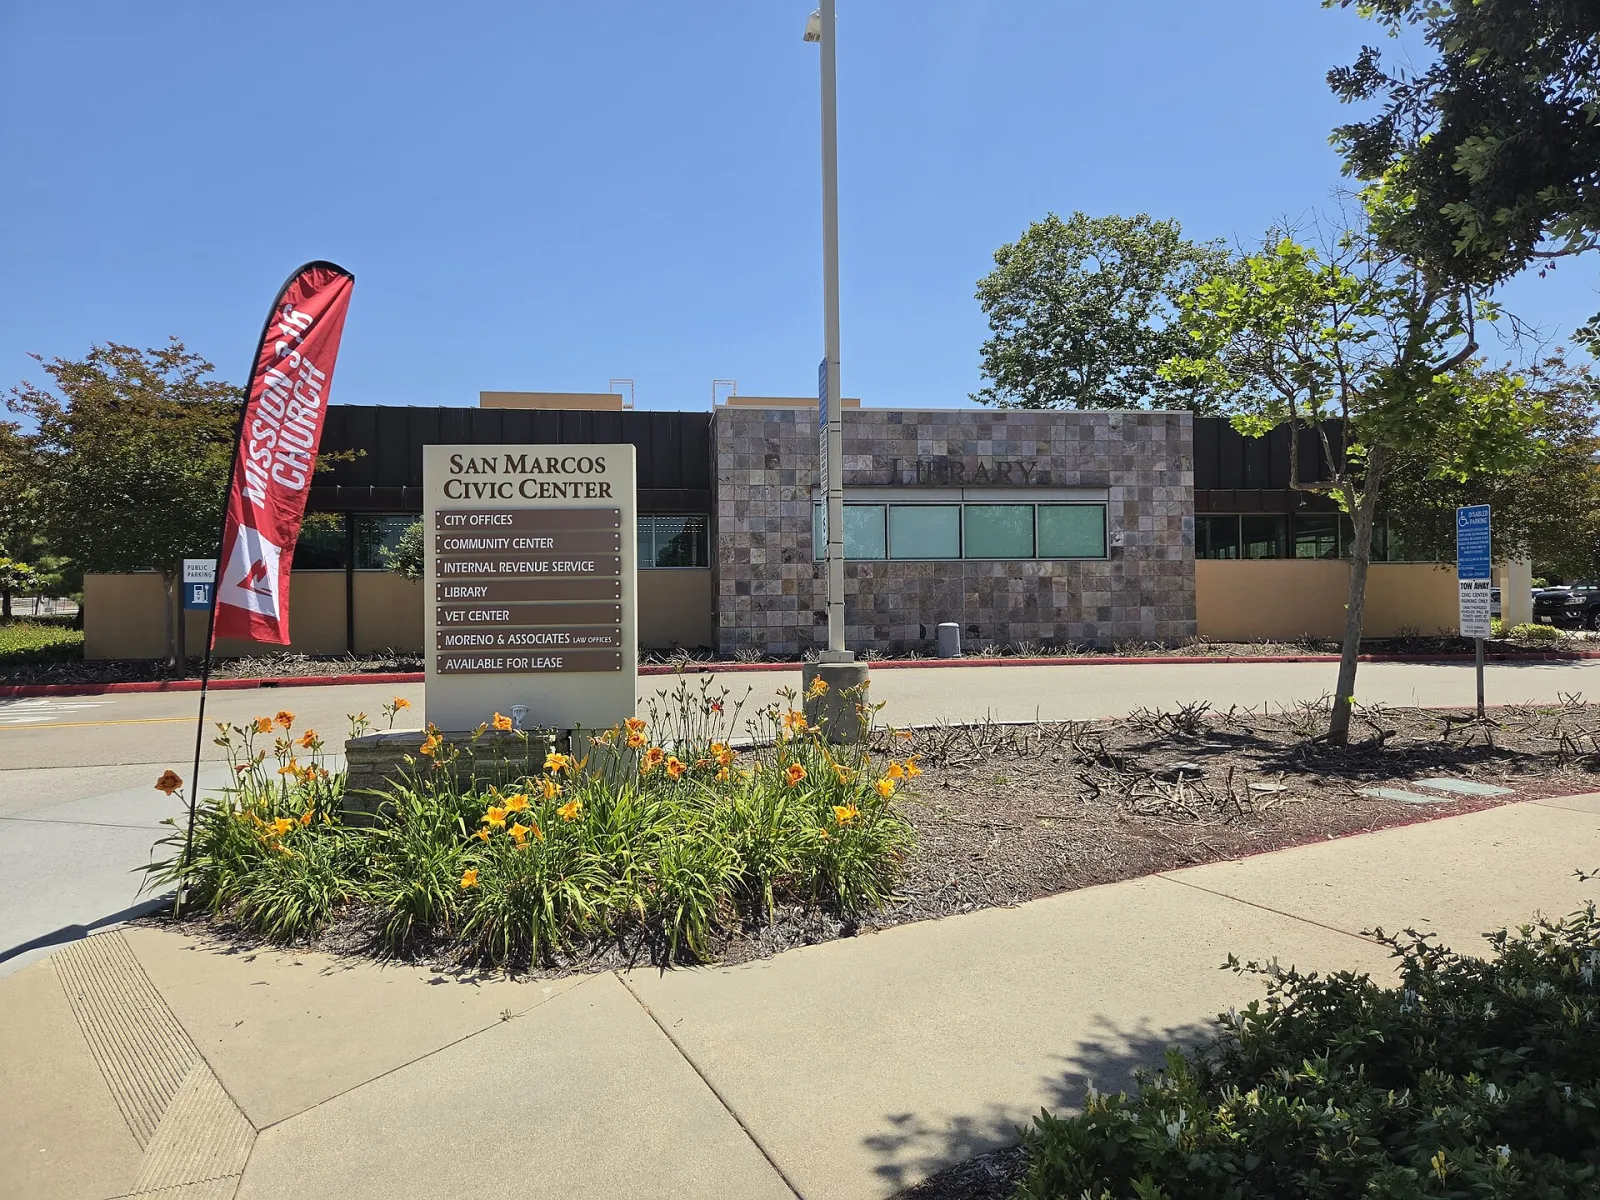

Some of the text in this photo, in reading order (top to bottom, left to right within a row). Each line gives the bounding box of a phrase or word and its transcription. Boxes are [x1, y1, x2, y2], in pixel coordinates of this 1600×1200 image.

[272, 357, 325, 491] CHURCH
[242, 365, 293, 509] MISSION
[888, 457, 1038, 486] LIBRARY
[444, 514, 513, 526] CITY OFFICES
[444, 537, 554, 550] COMMUNITY CENTER
[444, 560, 595, 573] INTERNAL REVENUE SERVICE
[444, 586, 488, 598] LIBRARY
[1460, 582, 1489, 590] TOW AWAY
[445, 610, 510, 622] VET CENTER
[445, 634, 494, 646] MORENO
[497, 634, 505, 645] &
[507, 633, 570, 645] ASSOCIATES
[587, 636, 612, 644] OFFICES
[445, 657, 563, 670] AVAILABLE FOR LEASE
